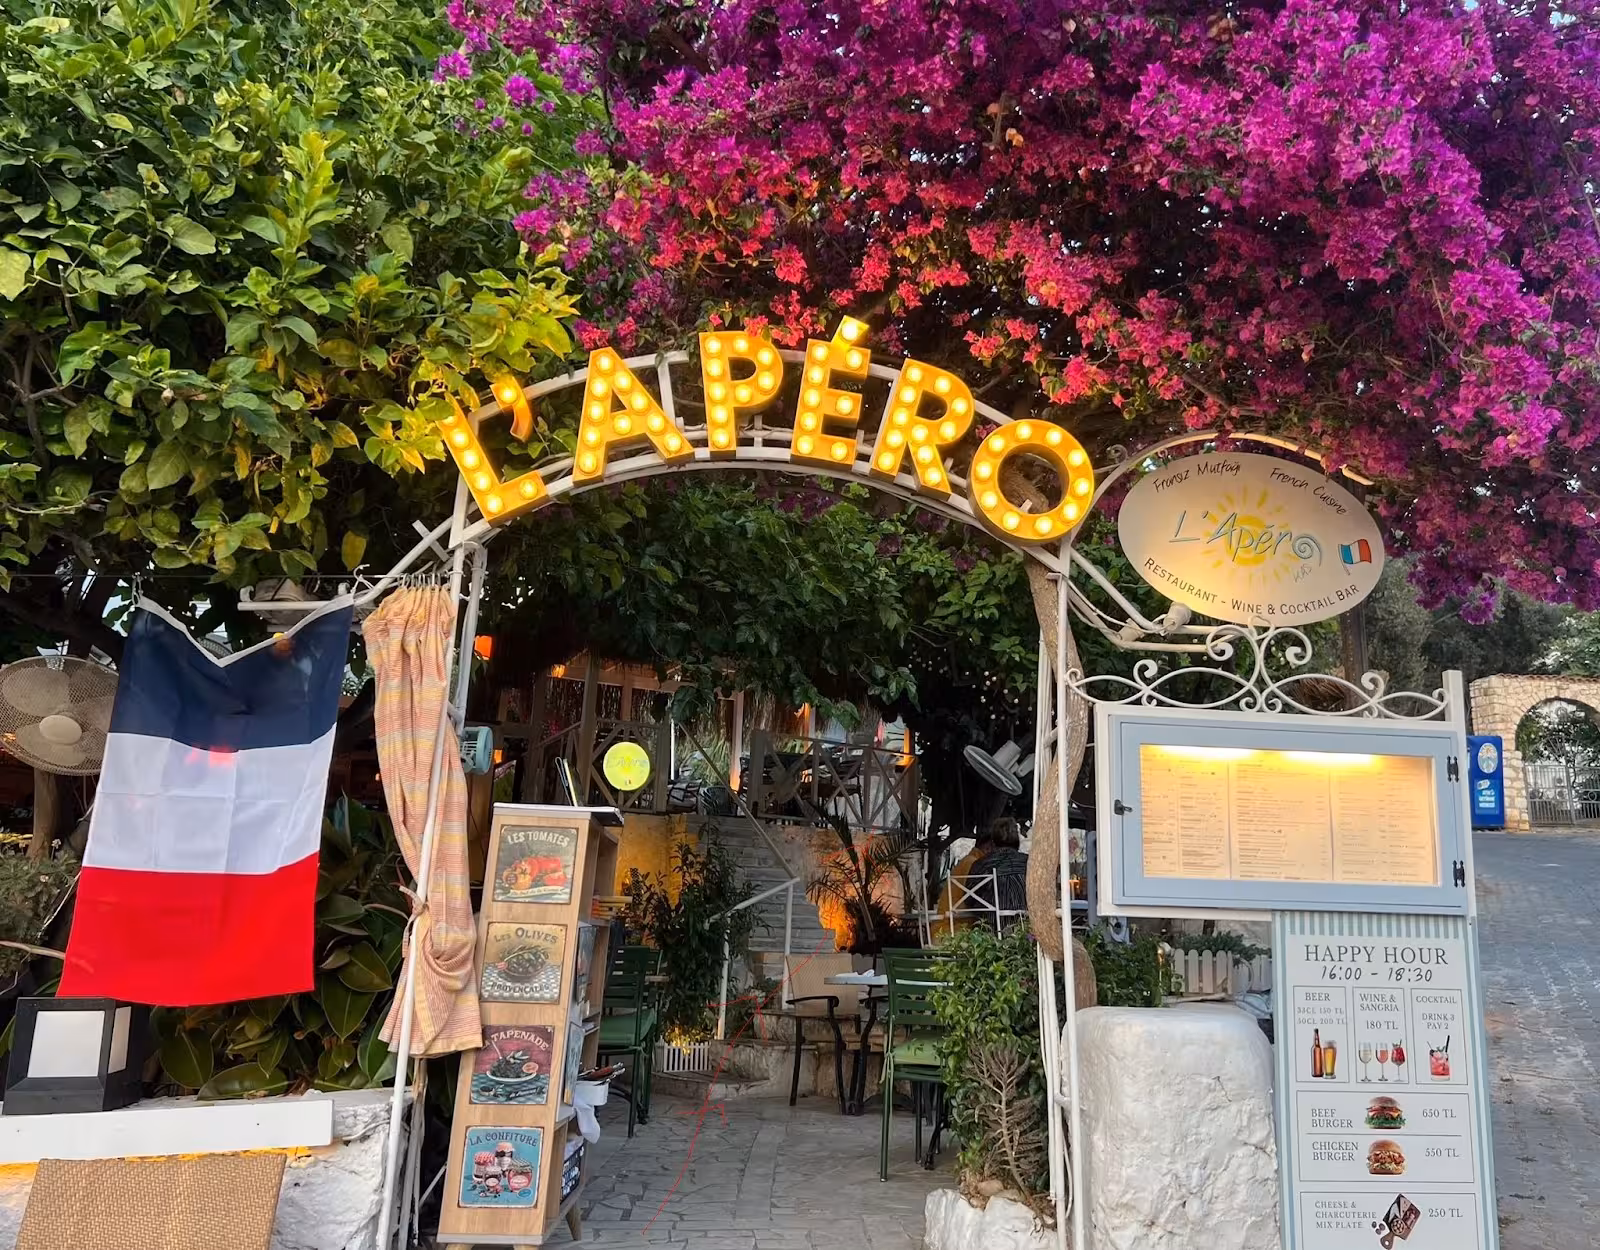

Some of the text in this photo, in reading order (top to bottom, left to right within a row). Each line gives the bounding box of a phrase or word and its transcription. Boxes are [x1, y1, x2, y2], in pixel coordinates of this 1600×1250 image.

[435, 316, 1095, 546] L'APÉRO
[1269, 467, 1347, 514] French Cuisine
[1144, 557, 1218, 604] RESTAURANT
[1267, 603, 1276, 615] &
[1280, 596, 1336, 615] COCKTAIL
[1335, 584, 1360, 601] BAR
[507, 831, 570, 847] LES TOMATES
[515, 927, 558, 944] OLIVES
[1304, 945, 1448, 964] HAPPY HOUR
[1322, 965, 1362, 980] 16:00
[1388, 967, 1432, 982] 18:30
[1305, 992, 1331, 1001] BEER
[1359, 993, 1397, 1003] WINE &
[1415, 995, 1457, 1004] COCKTAIL
[1335, 1007, 1345, 1015] TL
[1359, 1003, 1399, 1012] SANGRIA
[1422, 1012, 1448, 1021] DRINK
[1366, 1020, 1399, 1030] 180 TL
[1427, 1022, 1450, 1030] PAY 2
[491, 1030, 549, 1051] TAPENADE
[1311, 1108, 1336, 1118] BEEF
[1422, 1109, 1456, 1118] 650 TL
[1312, 1119, 1353, 1128] BURGER
[469, 1132, 538, 1147] LA CONFITURE
[1312, 1141, 1359, 1151] CHICKEN
[1313, 1152, 1355, 1161] BURGER
[1425, 1148, 1459, 1158] 550 TL
[1315, 1200, 1357, 1209] CHEESE &
[1315, 1211, 1377, 1219] CHARCUTERIE
[1428, 1208, 1463, 1218] 250 TL
[1316, 1221, 1363, 1229] MIX PLATE
